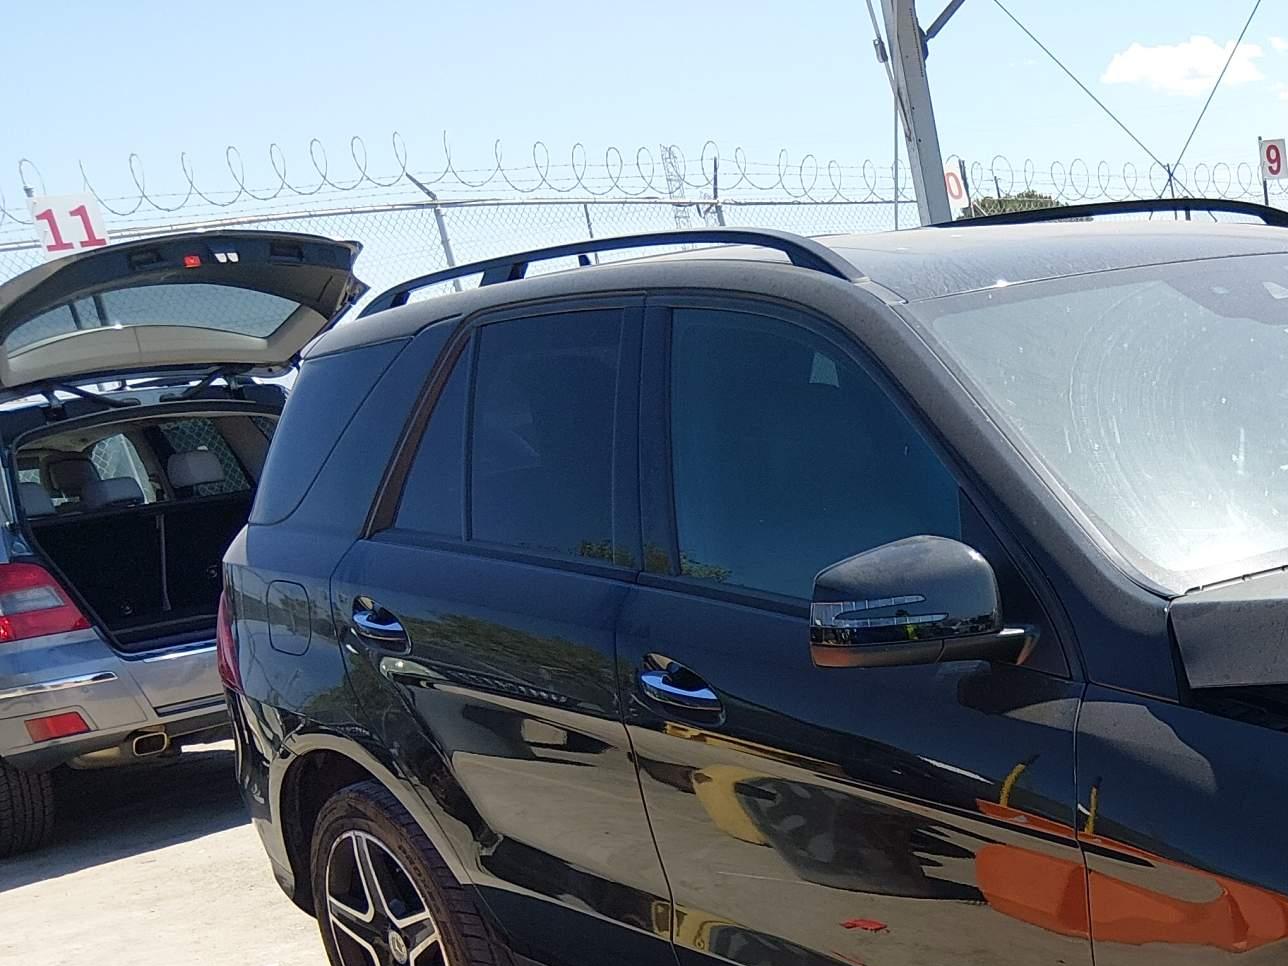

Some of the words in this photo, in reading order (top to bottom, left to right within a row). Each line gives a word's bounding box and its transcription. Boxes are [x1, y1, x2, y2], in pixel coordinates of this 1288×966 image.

[1265, 144, 1281, 176] 9
[944, 172, 963, 200] 0
[35, 205, 107, 252] 11
